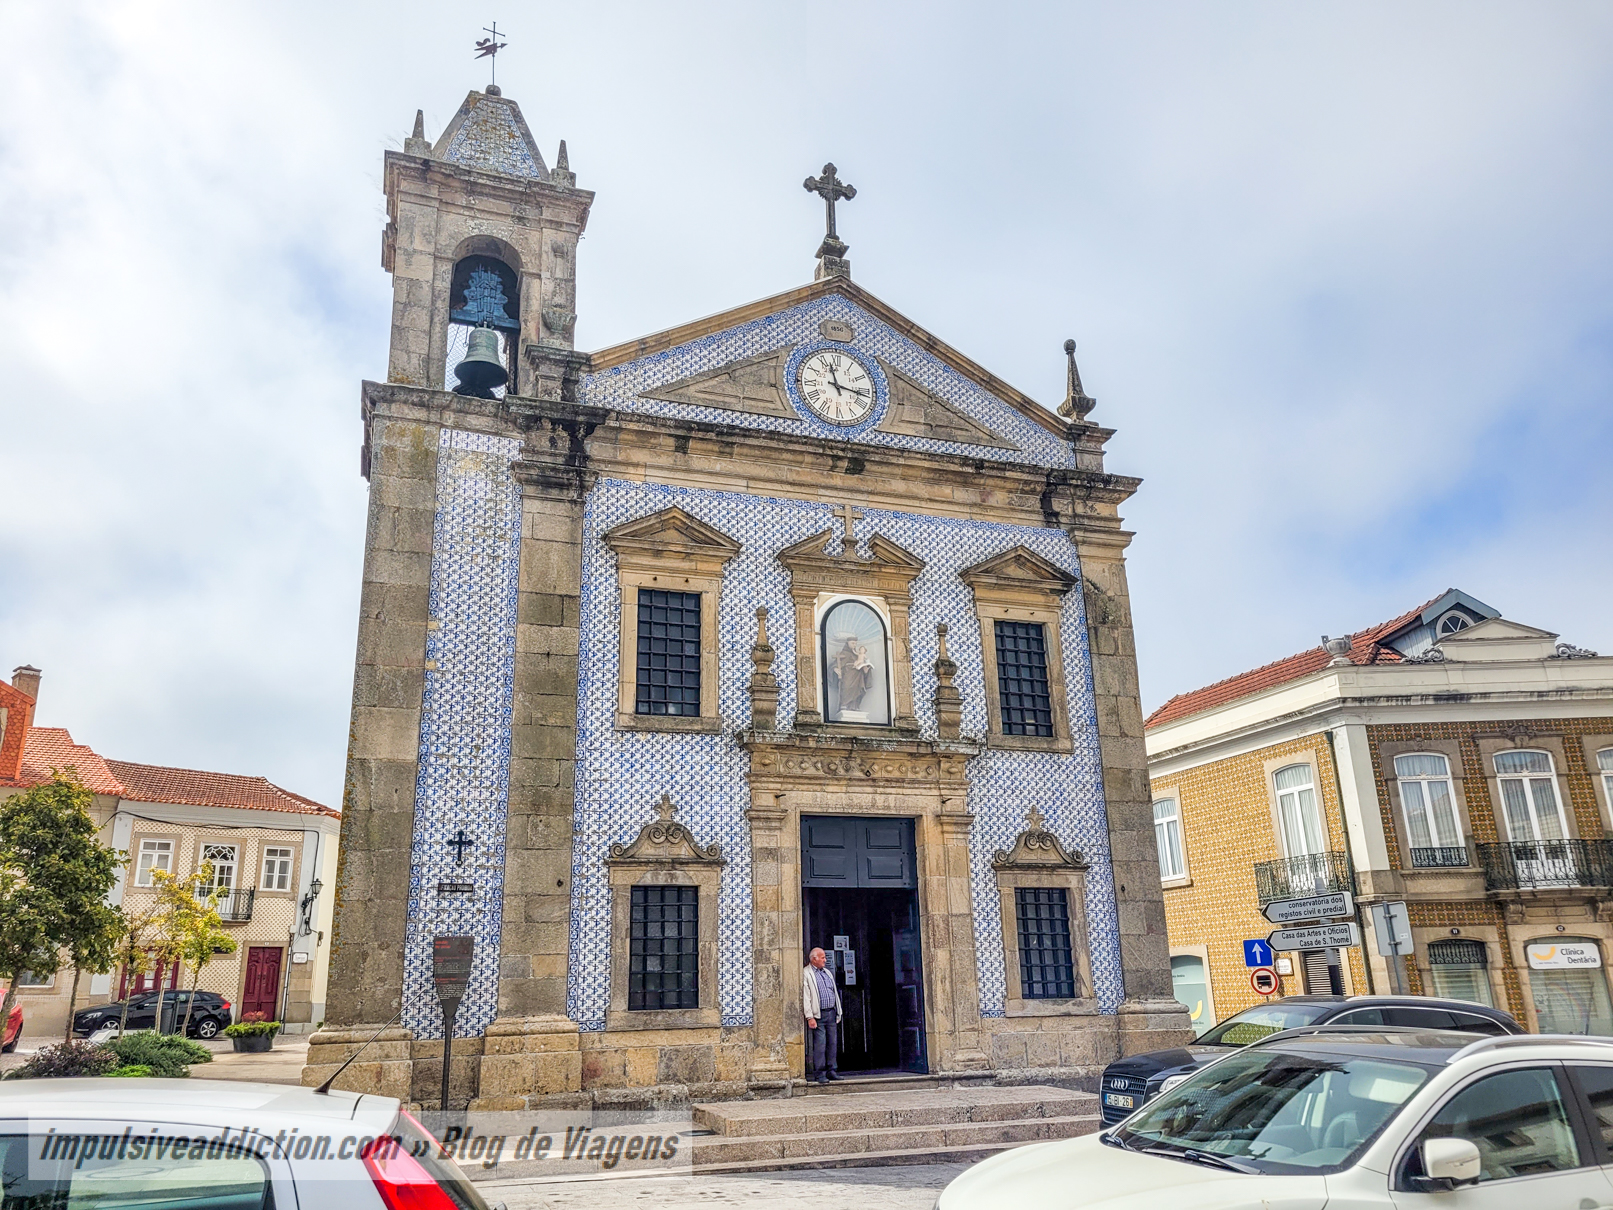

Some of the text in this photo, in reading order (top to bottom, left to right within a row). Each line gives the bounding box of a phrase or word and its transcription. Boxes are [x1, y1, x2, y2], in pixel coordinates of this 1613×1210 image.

[1278, 910, 1303, 919] registos
[1303, 908, 1316, 916] civil
[1322, 904, 1345, 915] predial
[1281, 932, 1295, 940] Casa
[1295, 930, 1306, 938] das
[1299, 935, 1350, 947] Casa de S. Thomé
[1560, 947, 1585, 956] Clínica
[1567, 955, 1597, 964] Dentária
